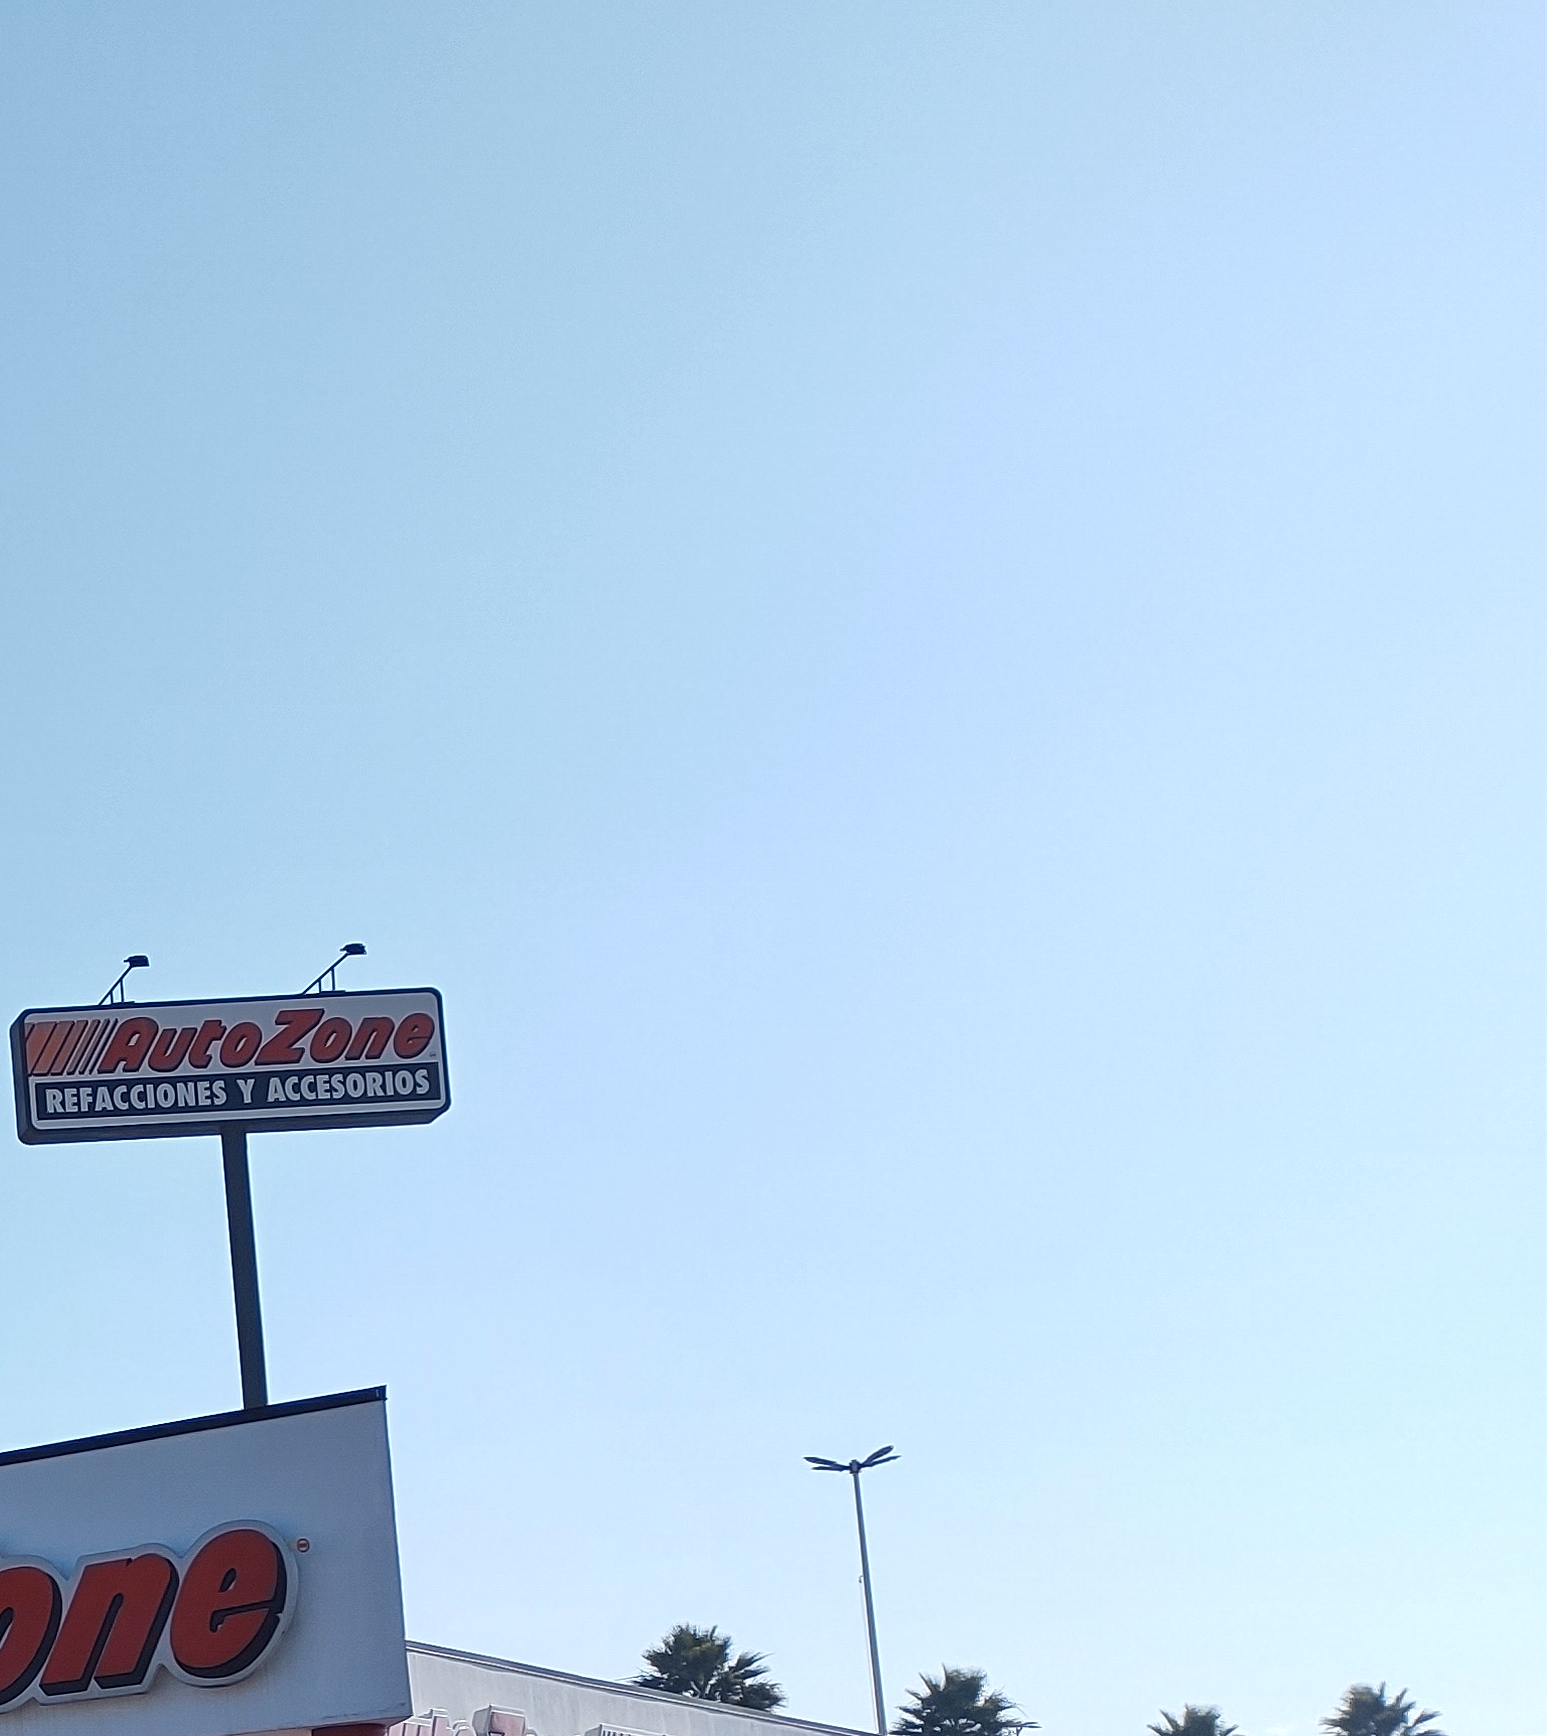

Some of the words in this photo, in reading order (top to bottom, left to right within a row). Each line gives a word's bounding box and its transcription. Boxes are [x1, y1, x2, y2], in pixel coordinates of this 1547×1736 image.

[99, 1008, 436, 1074] AutoZone
[45, 1079, 228, 1115] REFACCIONES
[237, 1077, 256, 1104] Y
[267, 1068, 431, 1102] ACCESORIOS
